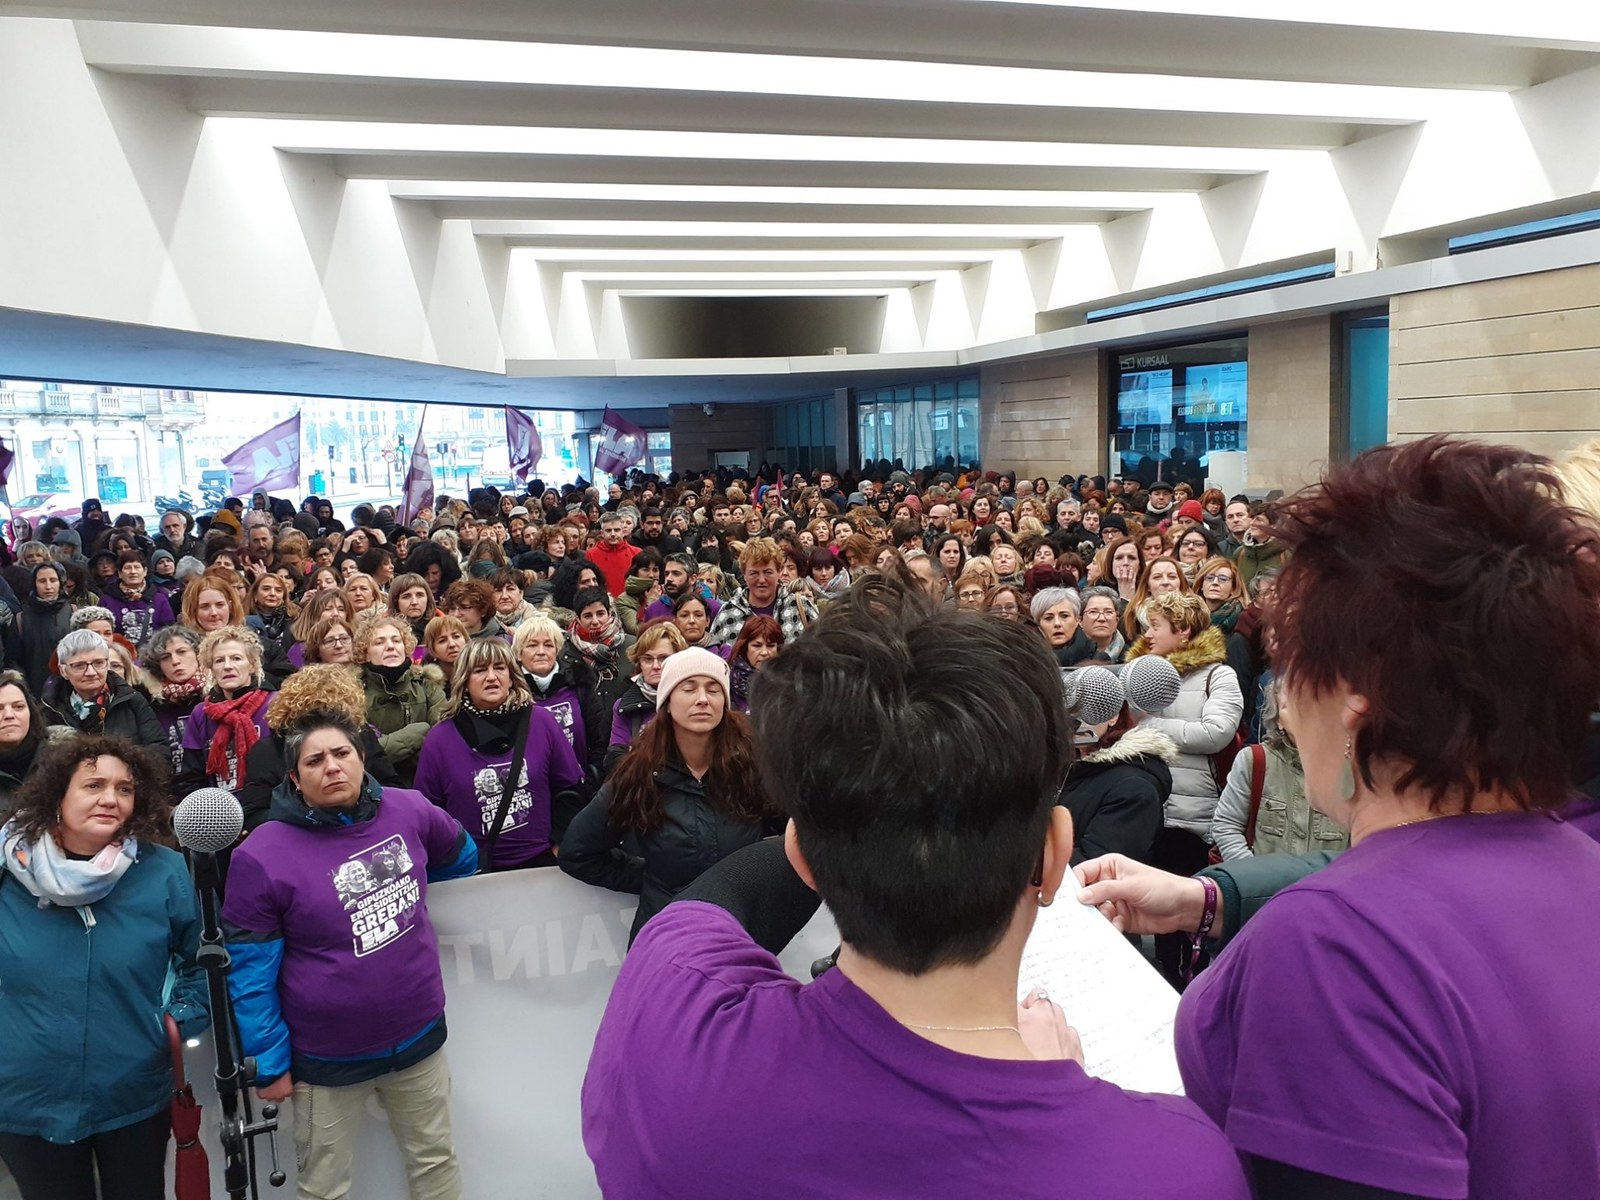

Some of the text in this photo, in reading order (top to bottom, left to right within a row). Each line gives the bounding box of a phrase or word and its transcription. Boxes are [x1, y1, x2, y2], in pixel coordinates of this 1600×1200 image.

[1137, 354, 1169, 368] KURSAAL
[486, 789, 526, 805] GIPUAKO
[350, 879, 419, 922] ERRESIDENTZIAK
[357, 875, 411, 910] GIPUZKOAKO
[352, 887, 420, 936] GREBAN!
[361, 918, 399, 948] ELA
